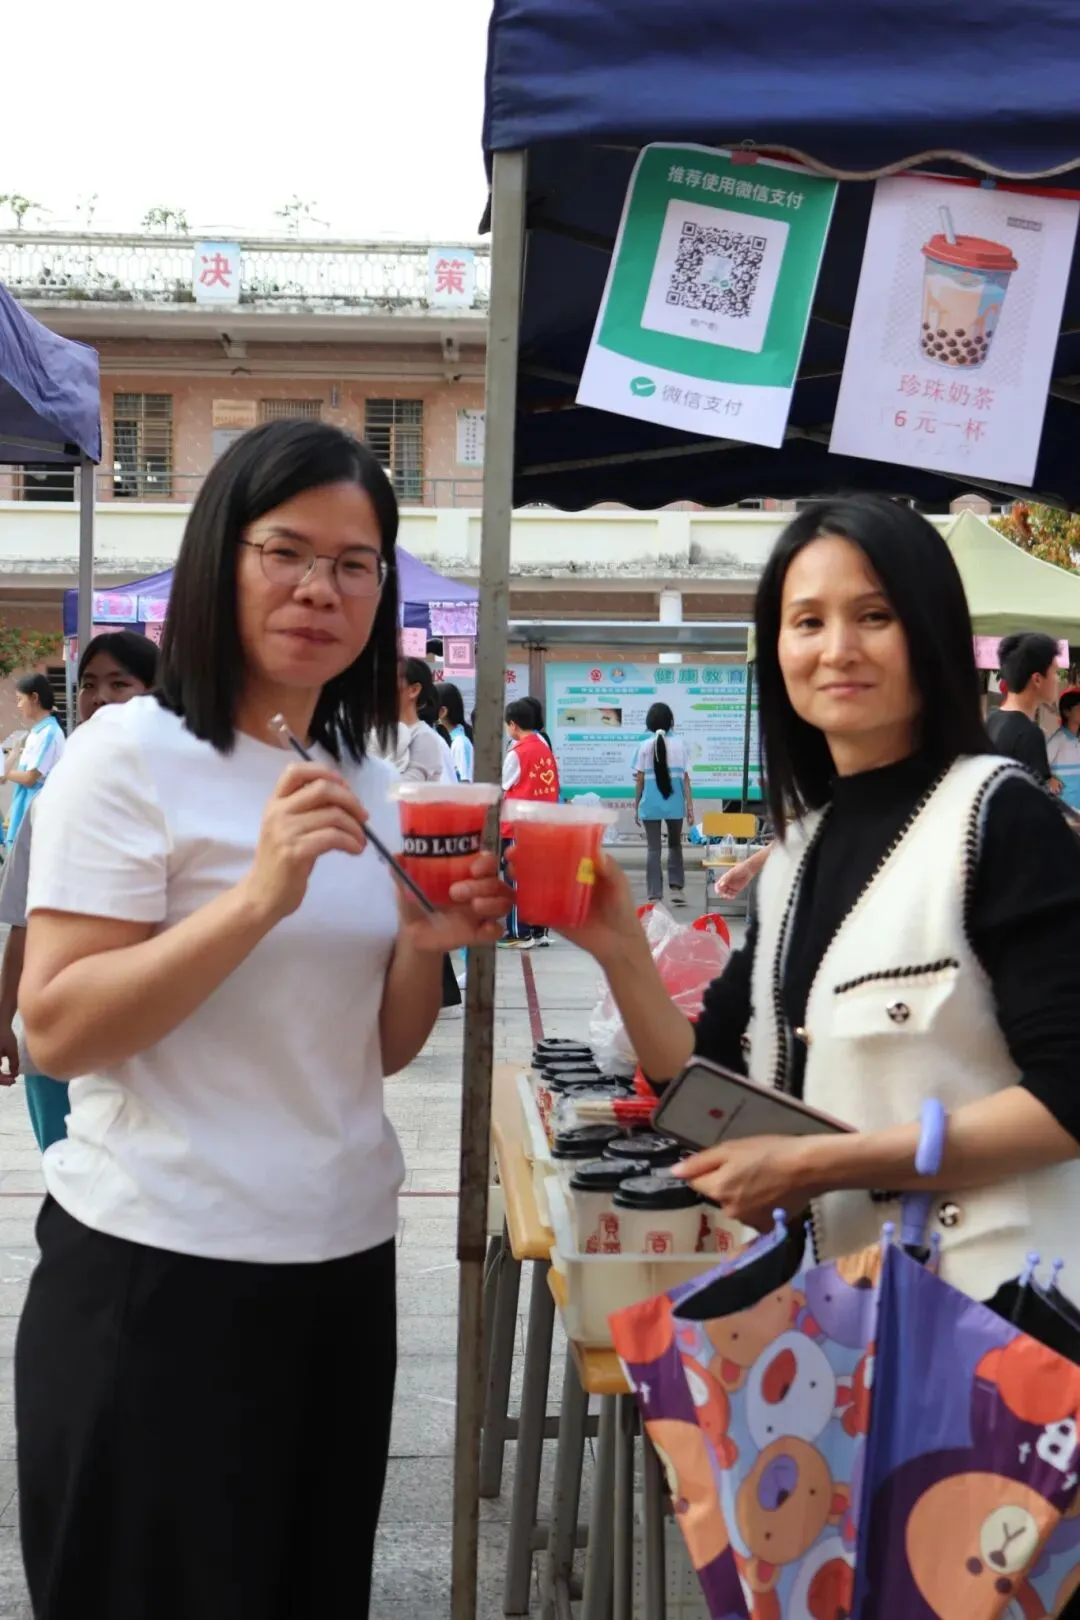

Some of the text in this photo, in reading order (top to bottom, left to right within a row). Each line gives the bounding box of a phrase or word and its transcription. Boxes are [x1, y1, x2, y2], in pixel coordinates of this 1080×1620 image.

[667, 165, 804, 209] 推荐使用微信支付
[199, 252, 467, 295] 决 策
[661, 385, 743, 416] 微信支付
[897, 374, 995, 410] 珍珠奶茶
